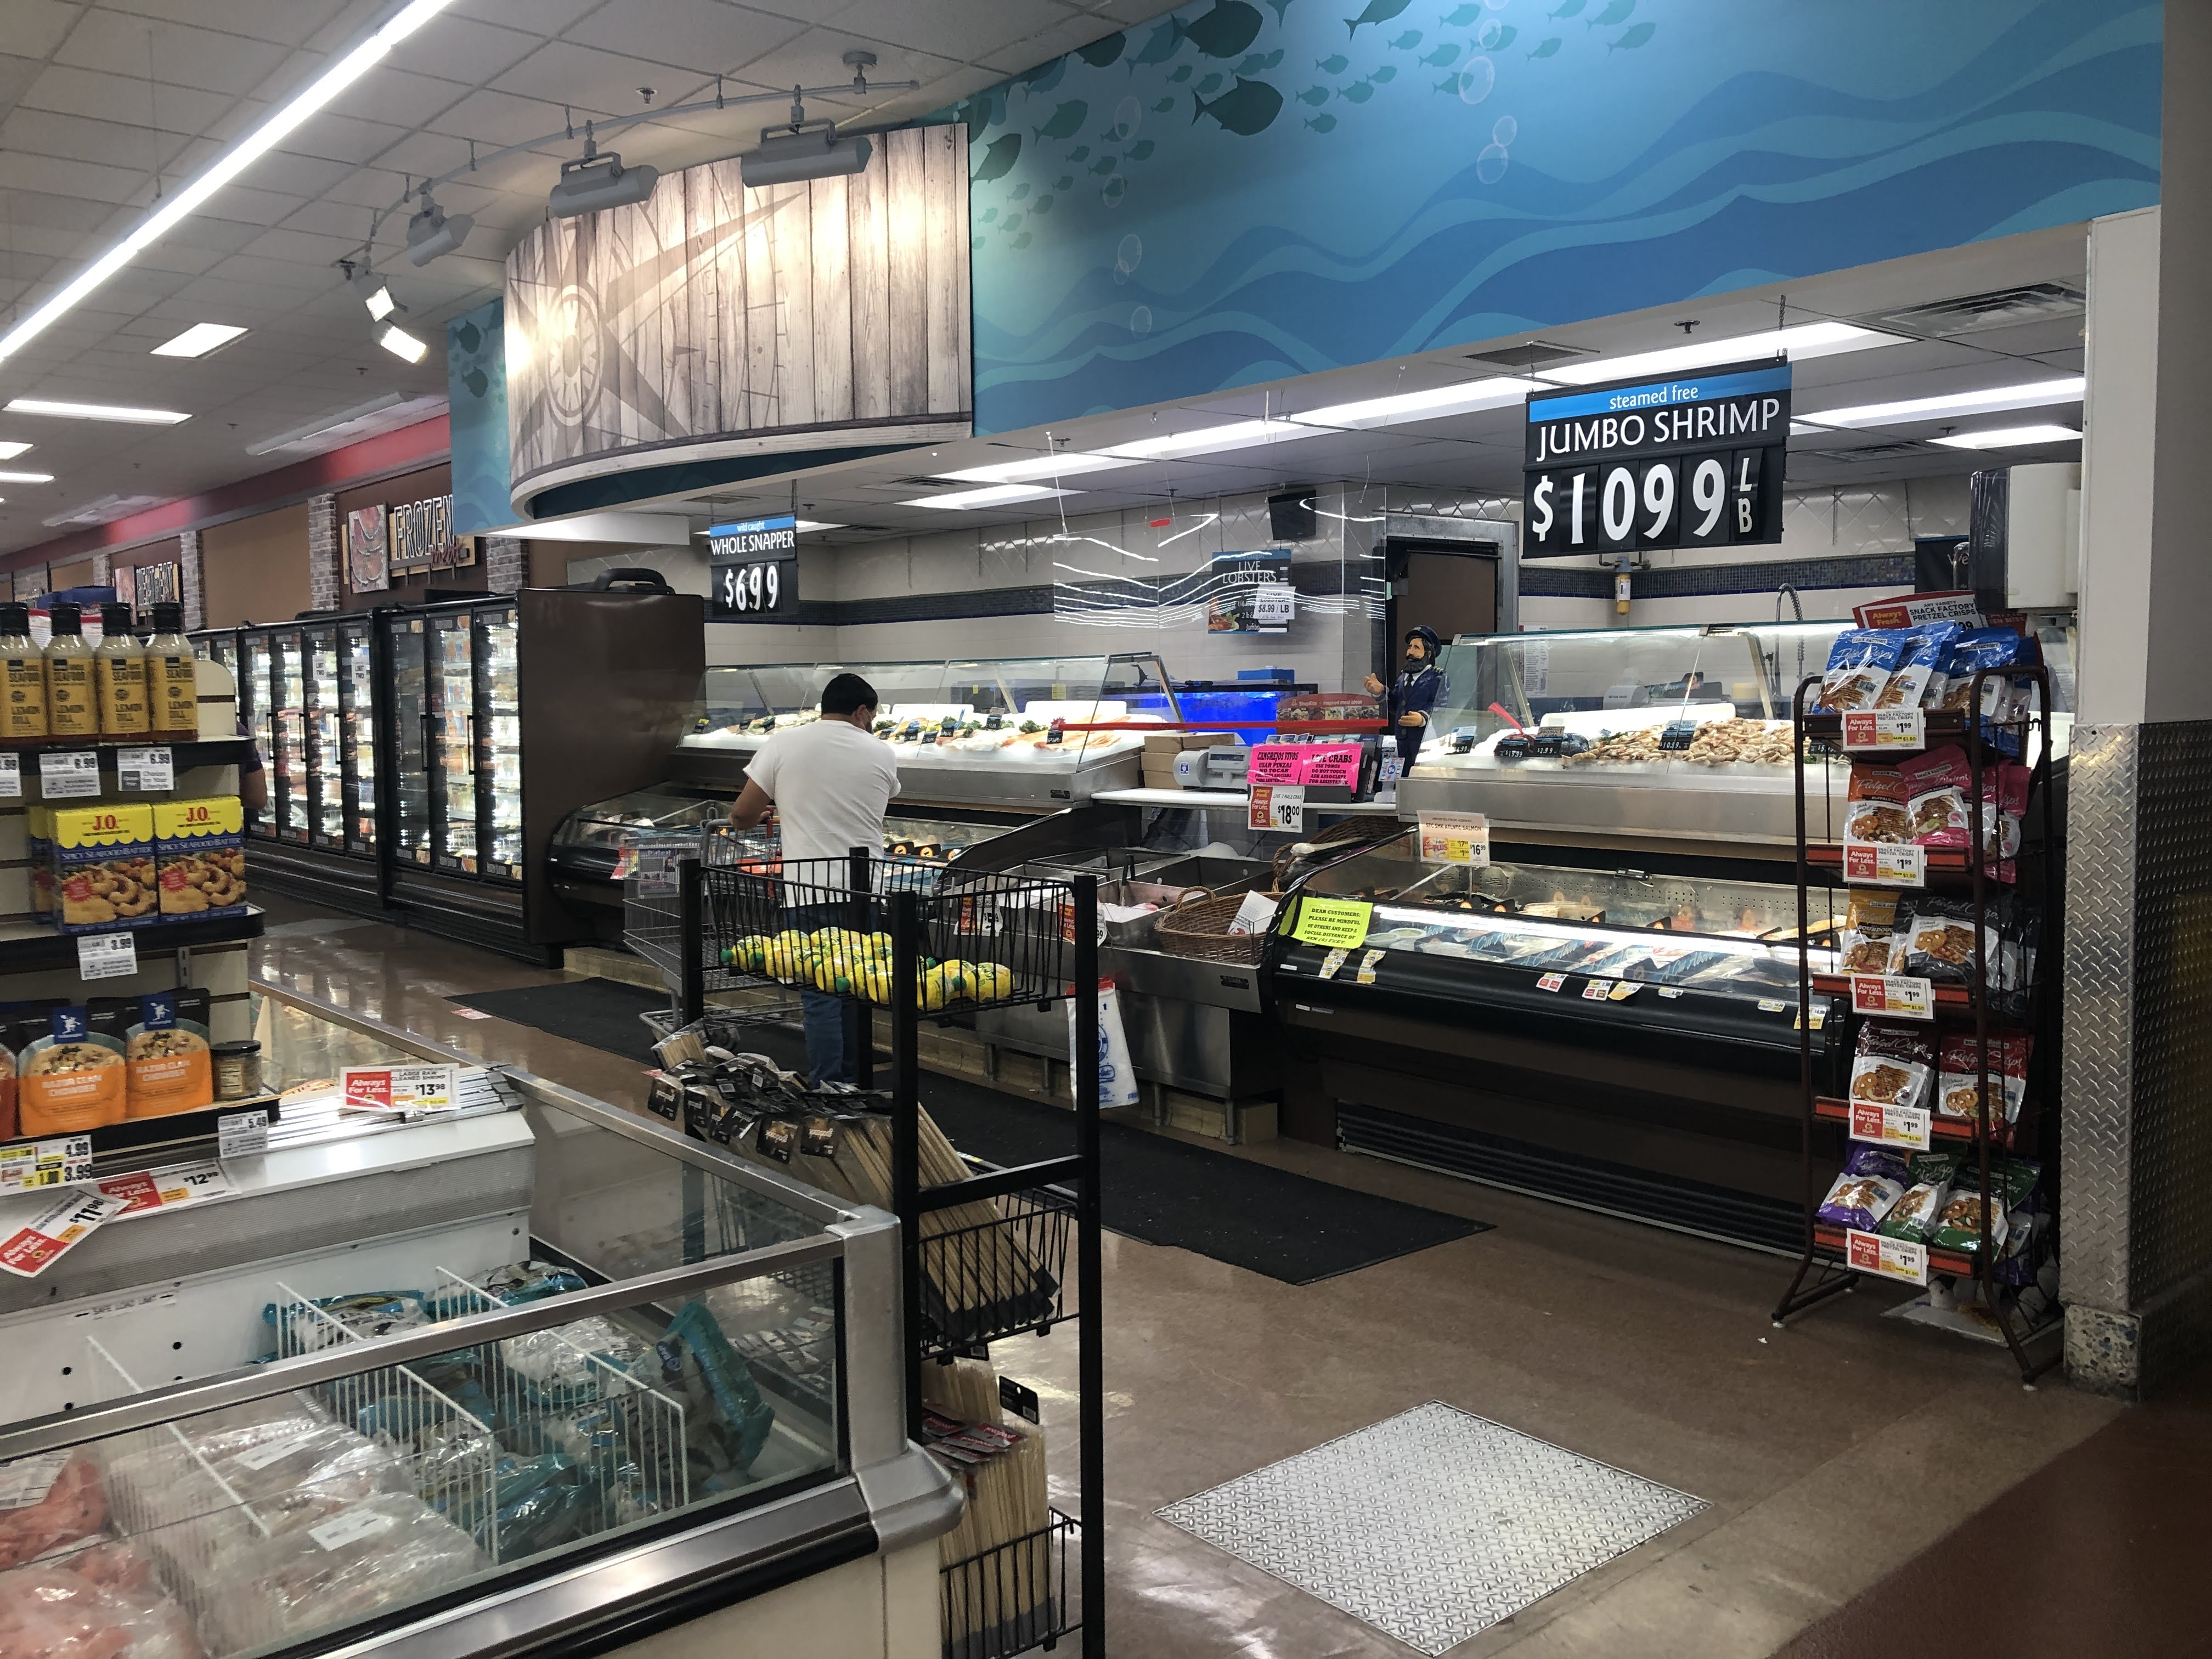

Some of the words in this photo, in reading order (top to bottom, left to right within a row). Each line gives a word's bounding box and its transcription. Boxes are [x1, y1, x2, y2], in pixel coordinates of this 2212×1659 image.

[1610, 388, 1667, 409] steamed
[1672, 386, 1699, 402] free
[1537, 415, 1645, 462] JUMBO
[1654, 398, 1780, 443] SHRIMP
[394, 494, 454, 560] FROZEN
[748, 522, 765, 532] caught
[710, 535, 747, 555] WHOLE
[749, 531, 794, 551] SNAPPER
[1238, 561, 1261, 571] LIVE
[1222, 572, 1277, 584] LOBSTERS
[1259, 604, 1274, 613] $8.99
[1280, 605, 1289, 613] LB
[1909, 607, 1936, 616] SNACK
[1938, 602, 1974, 612] FACTORY
[1872, 611, 1902, 620] Always
[1913, 613, 1947, 622] PRETZEL
[1948, 608, 1976, 617] CRISPS
[1877, 617, 1901, 625] Fresh.
[1257, 752, 1284, 763] CANGREJOS
[1284, 752, 1299, 760] VIVOS
[1328, 754, 1353, 763] CRABS
[1857, 779, 1893, 794] Pretzel
[185, 806, 211, 822] J.O.
[92, 814, 120, 831] J.O.
[1851, 851, 1874, 859] Always
[1859, 983, 1881, 991] Always
[351, 1079, 387, 1088] Always
[1858, 1109, 1880, 1119] Always
[1854, 1239, 1876, 1250] Always
